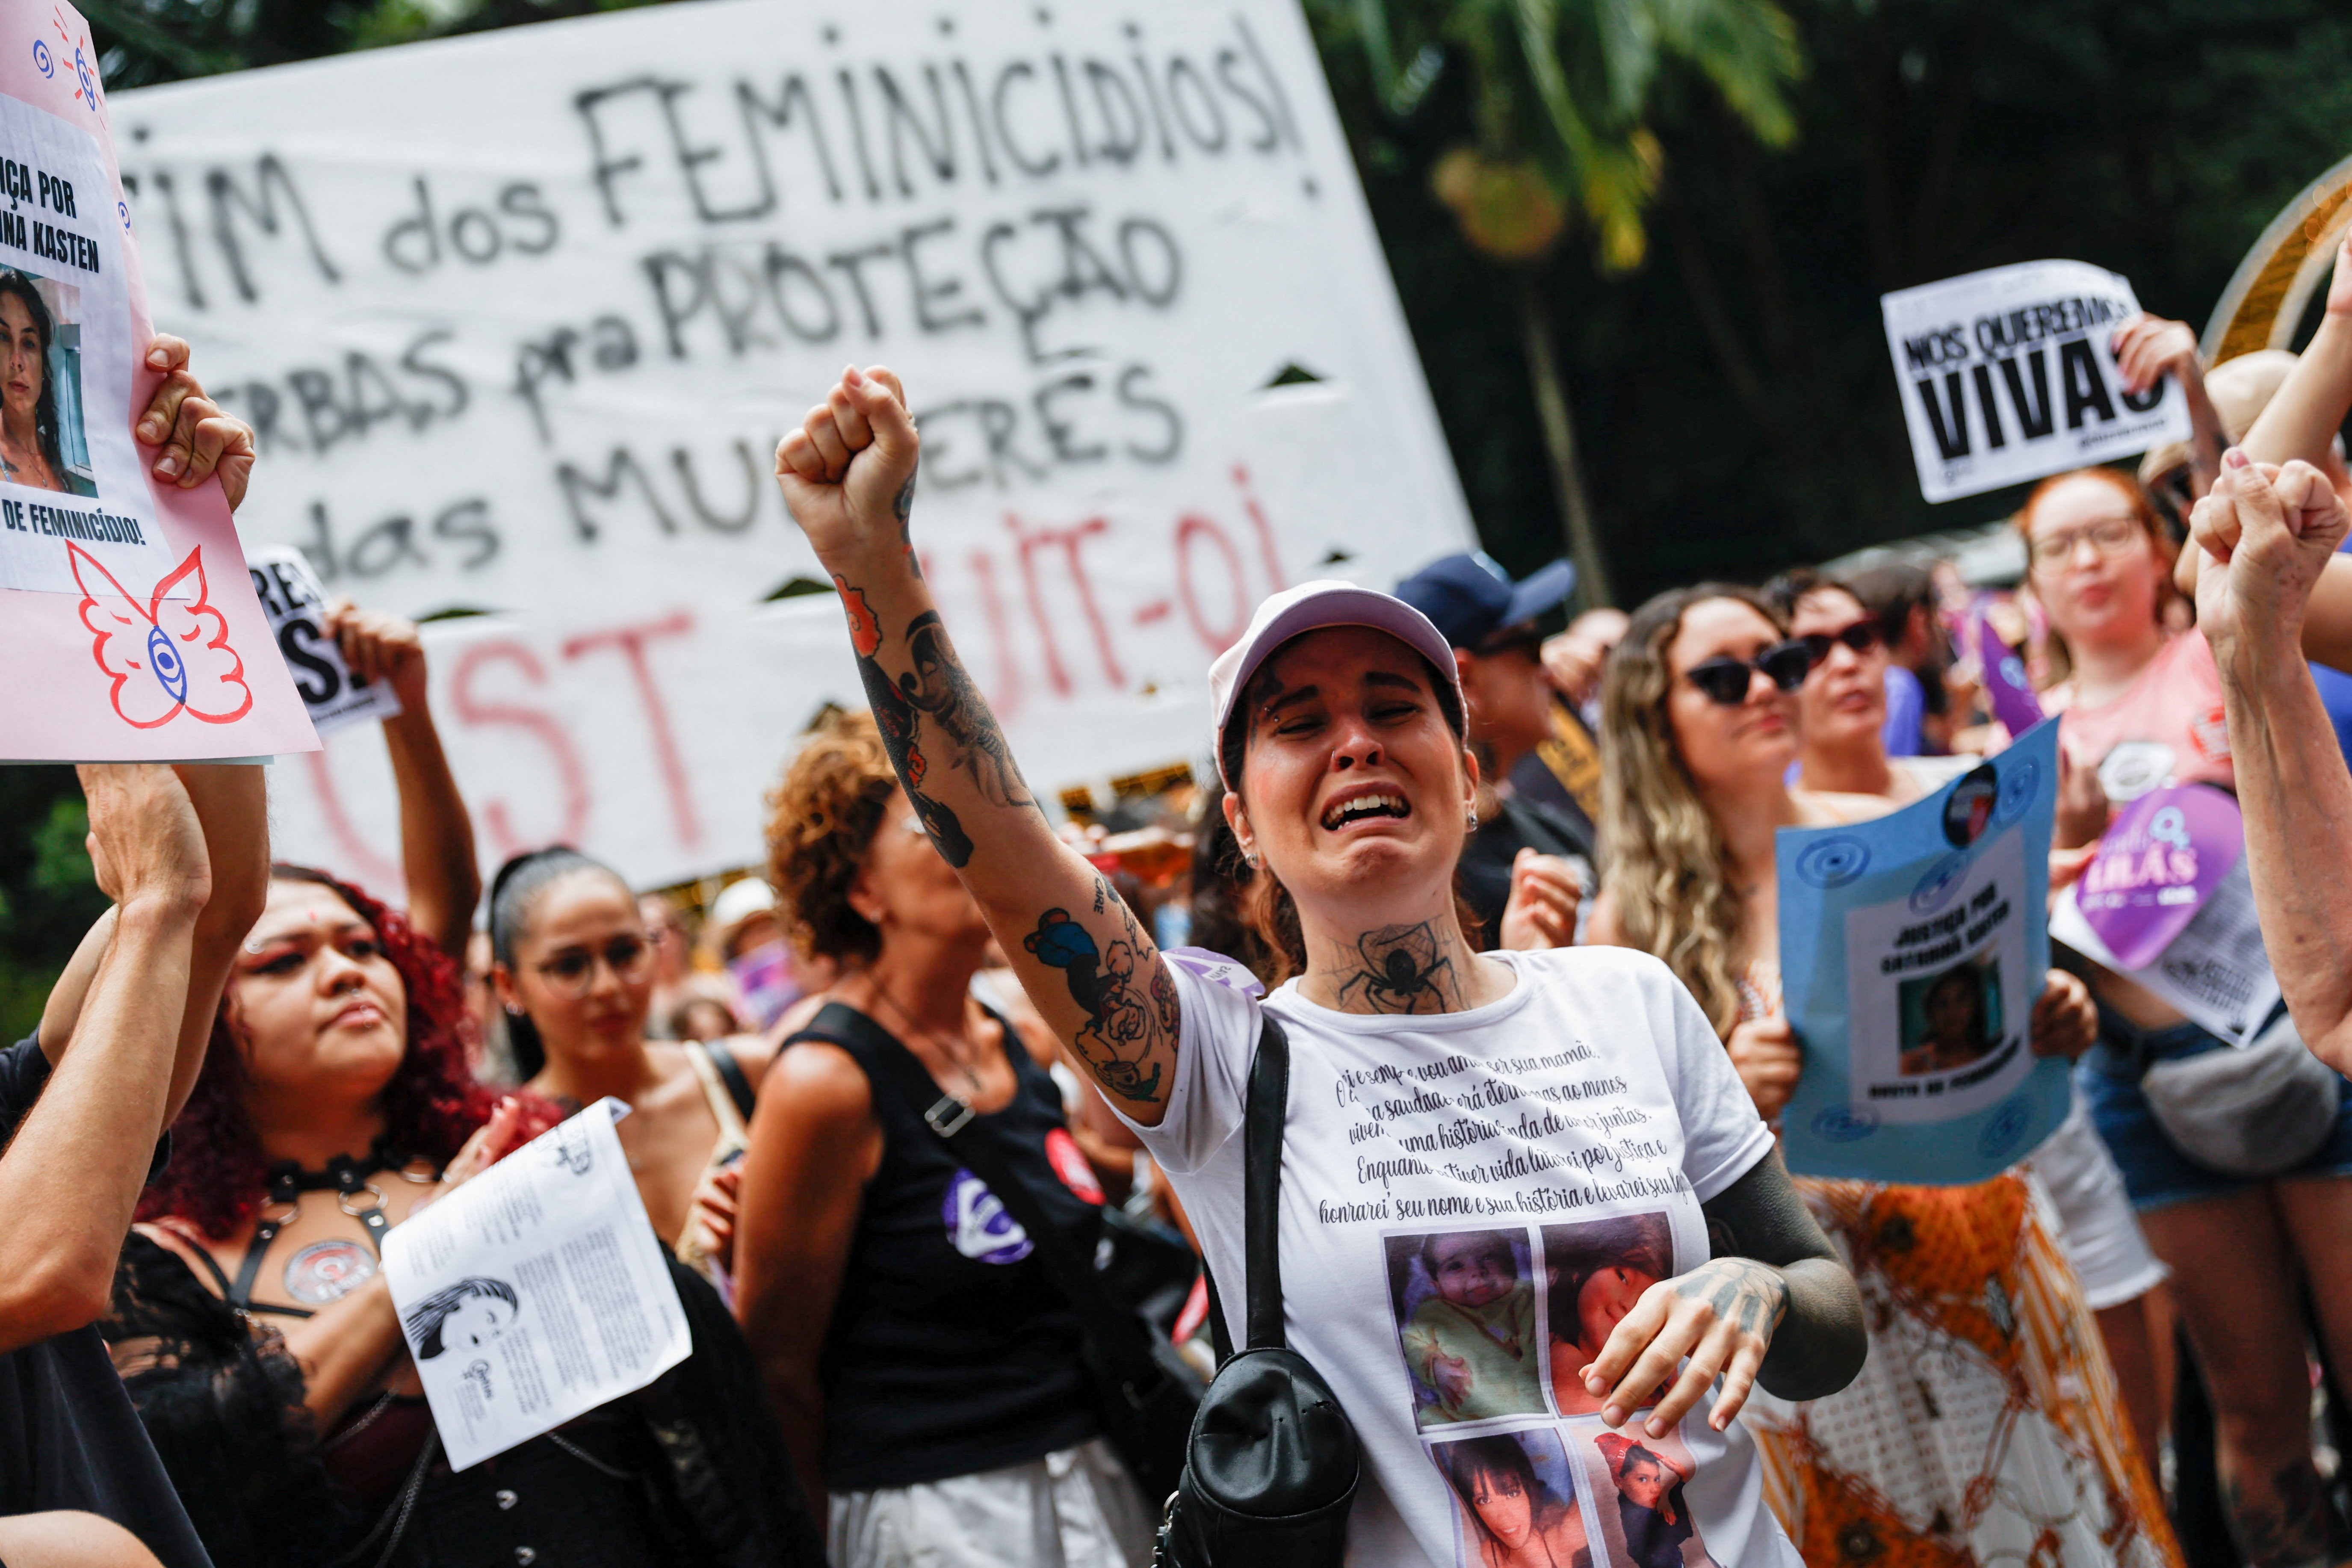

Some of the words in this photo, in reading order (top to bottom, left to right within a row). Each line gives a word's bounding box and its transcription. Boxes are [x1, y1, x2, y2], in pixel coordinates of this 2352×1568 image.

[38, 170, 77, 219] POR
[33, 220, 99, 273] KASTEN
[382, 176, 559, 274] dos
[299, 498, 504, 584] das
[555, 364, 1184, 542] MUERES
[2, 499, 27, 532] DE
[29, 507, 147, 546] FEMINICÍDIO!
[1418, 1061, 1448, 1082] vou
[1511, 1058, 1541, 1075] sua
[1562, 1084, 1582, 1101] ao
[1582, 1076, 1627, 1098] menos
[1544, 1107, 1564, 1135] de
[1489, 1149, 1529, 1182] vida
[1581, 1143, 1614, 1175] por
[1656, 1139, 1667, 1155] e
[1396, 1199, 1426, 1221] seu
[1427, 1196, 1474, 1217] nome
[1475, 1197, 1485, 1214] e
[1485, 1197, 1517, 1216] sua
[1515, 1187, 1583, 1215] história
[1584, 1187, 1595, 1205] e
[1593, 1178, 1649, 1202] levarei
[1646, 1176, 1672, 1198] seu
